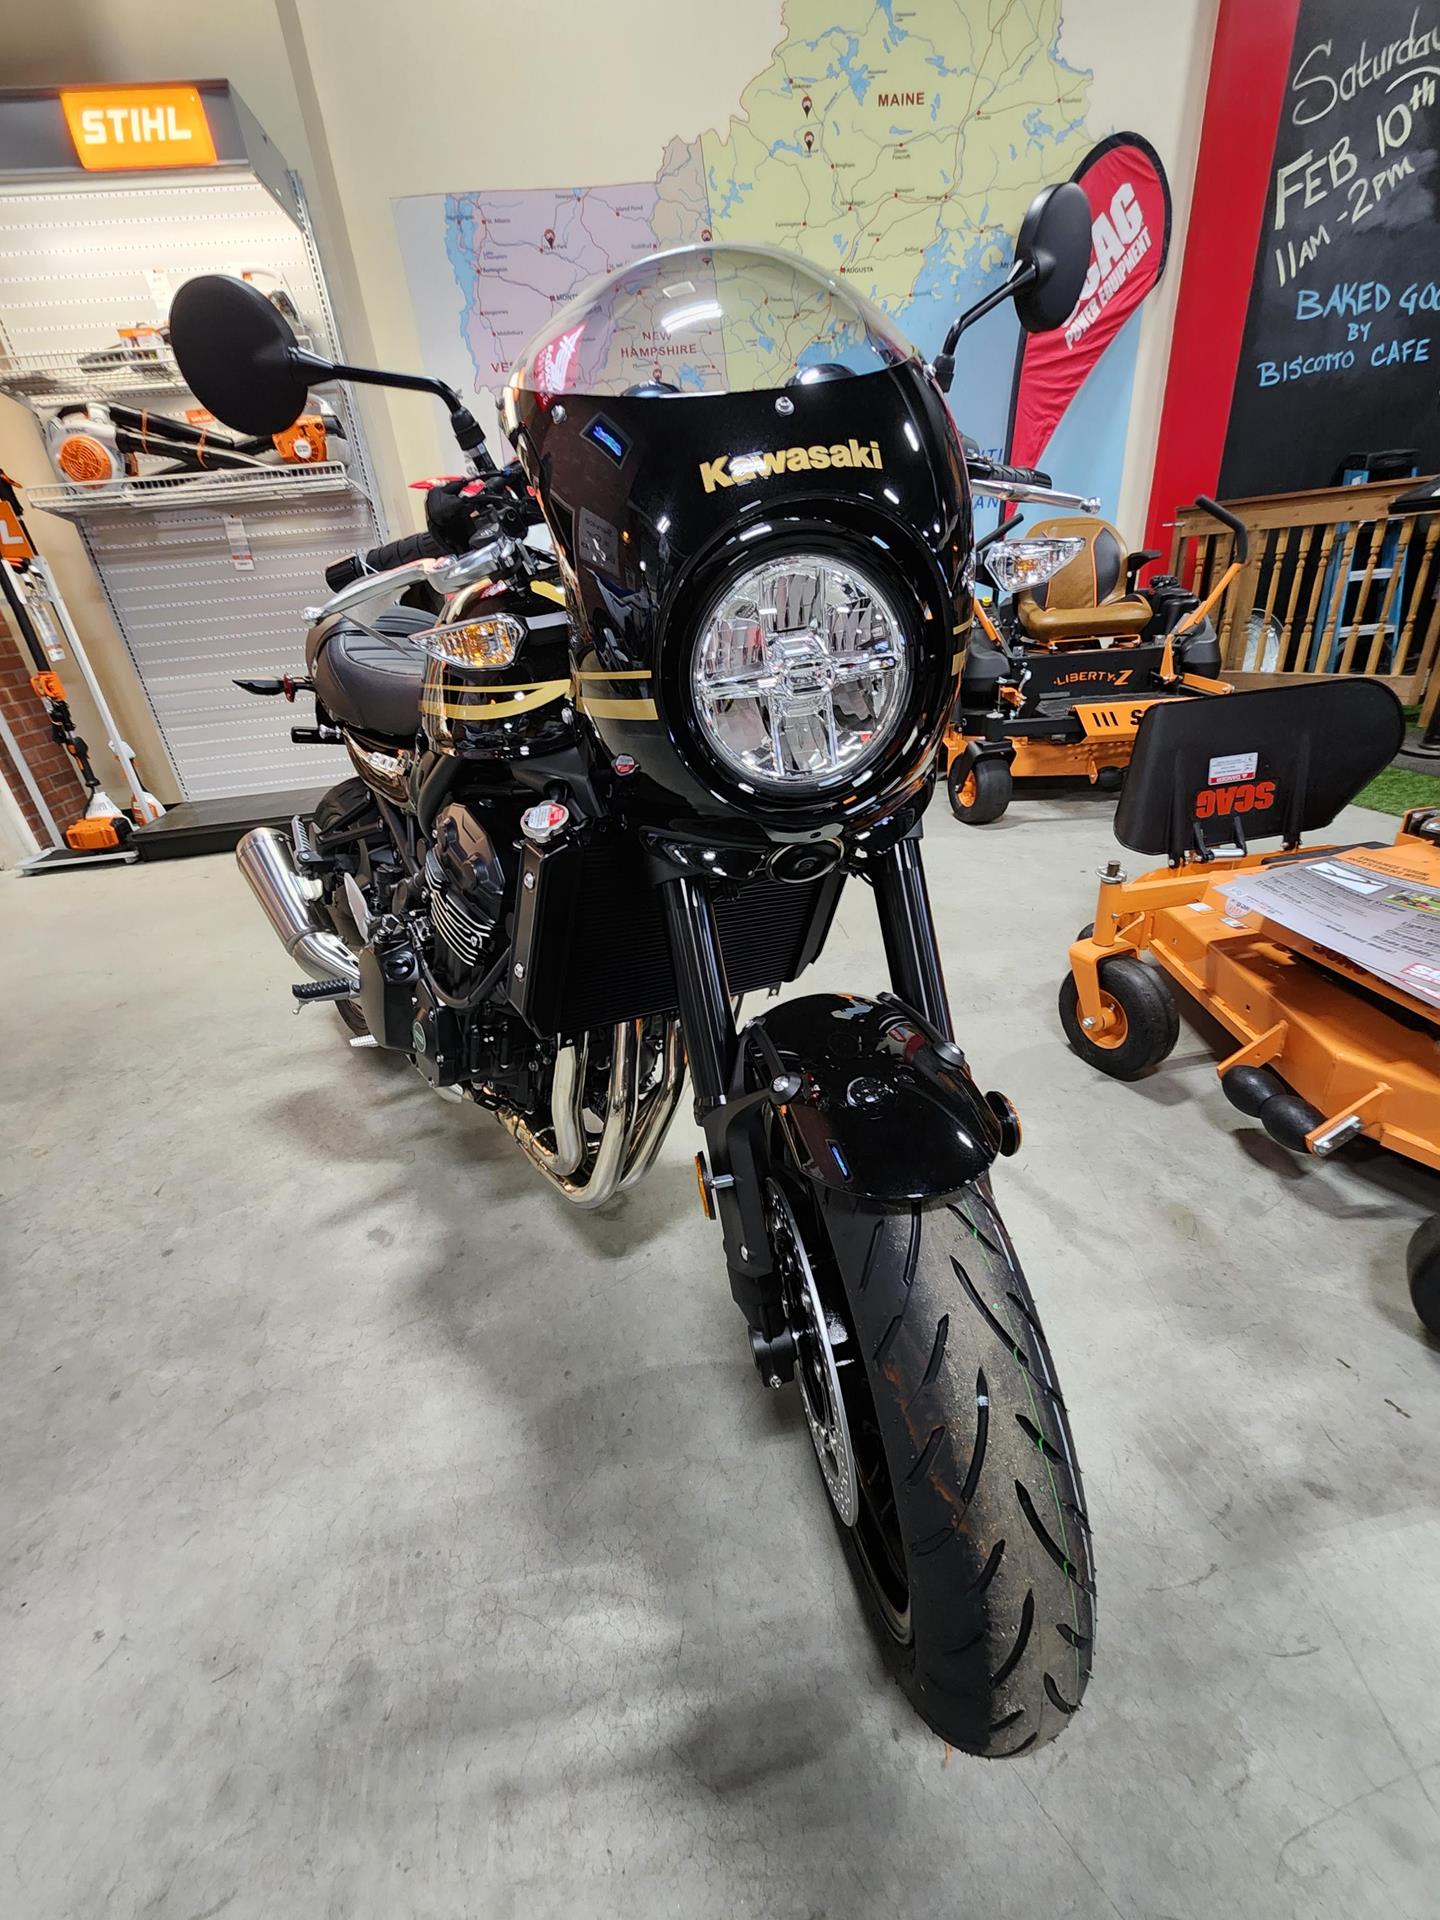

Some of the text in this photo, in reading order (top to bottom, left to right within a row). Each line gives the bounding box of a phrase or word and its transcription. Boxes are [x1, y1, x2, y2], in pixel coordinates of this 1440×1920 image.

[878, 92, 925, 107] MAINE
[81, 105, 192, 145] STIHL
[1274, 76, 1437, 231] FEB 10th
[1079, 182, 1143, 300] AG
[1274, 223, 1332, 288] 11AM
[846, 266, 873, 274] AUGUSTA
[1064, 226, 1153, 351] POWER EQUIPMENT
[556, 293, 577, 301] MONT
[1296, 281, 1391, 321] BAKED
[642, 331, 671, 341] NEW
[1347, 321, 1372, 343] BY
[491, 361, 513, 374] VE
[620, 344, 697, 358] HAMPSHIRE
[1257, 338, 1431, 388] BISCOTTO CAFE
[700, 438, 883, 493] Kawasaki
[1130, 709, 1145, 725] S
[1195, 781, 1276, 818] SCAG
